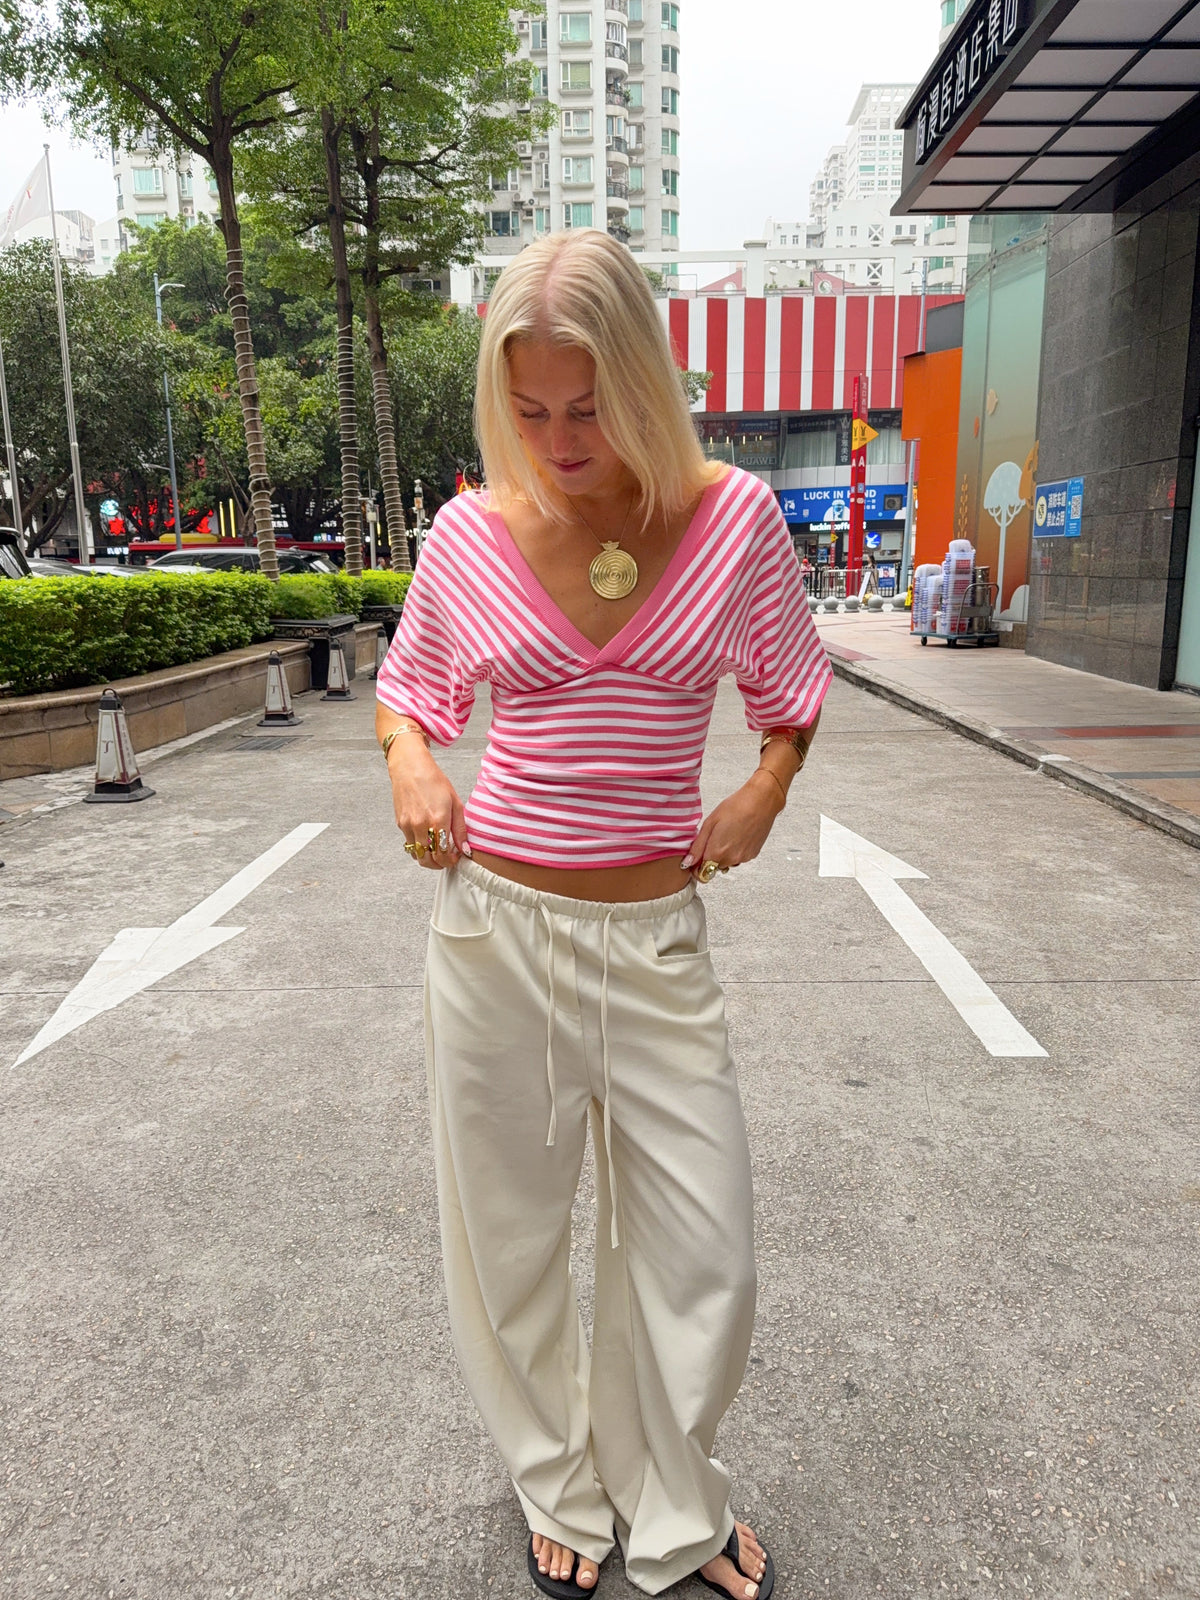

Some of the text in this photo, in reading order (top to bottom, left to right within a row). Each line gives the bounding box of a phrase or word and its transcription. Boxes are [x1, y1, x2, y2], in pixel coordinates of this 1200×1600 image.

[858, 455, 865, 467] A
[803, 489, 877, 501] LUCK IN HND
[1048, 491, 1067, 508] 消防车道
[1046, 510, 1065, 527] 禁止占用
[809, 523, 831, 531] luckin
